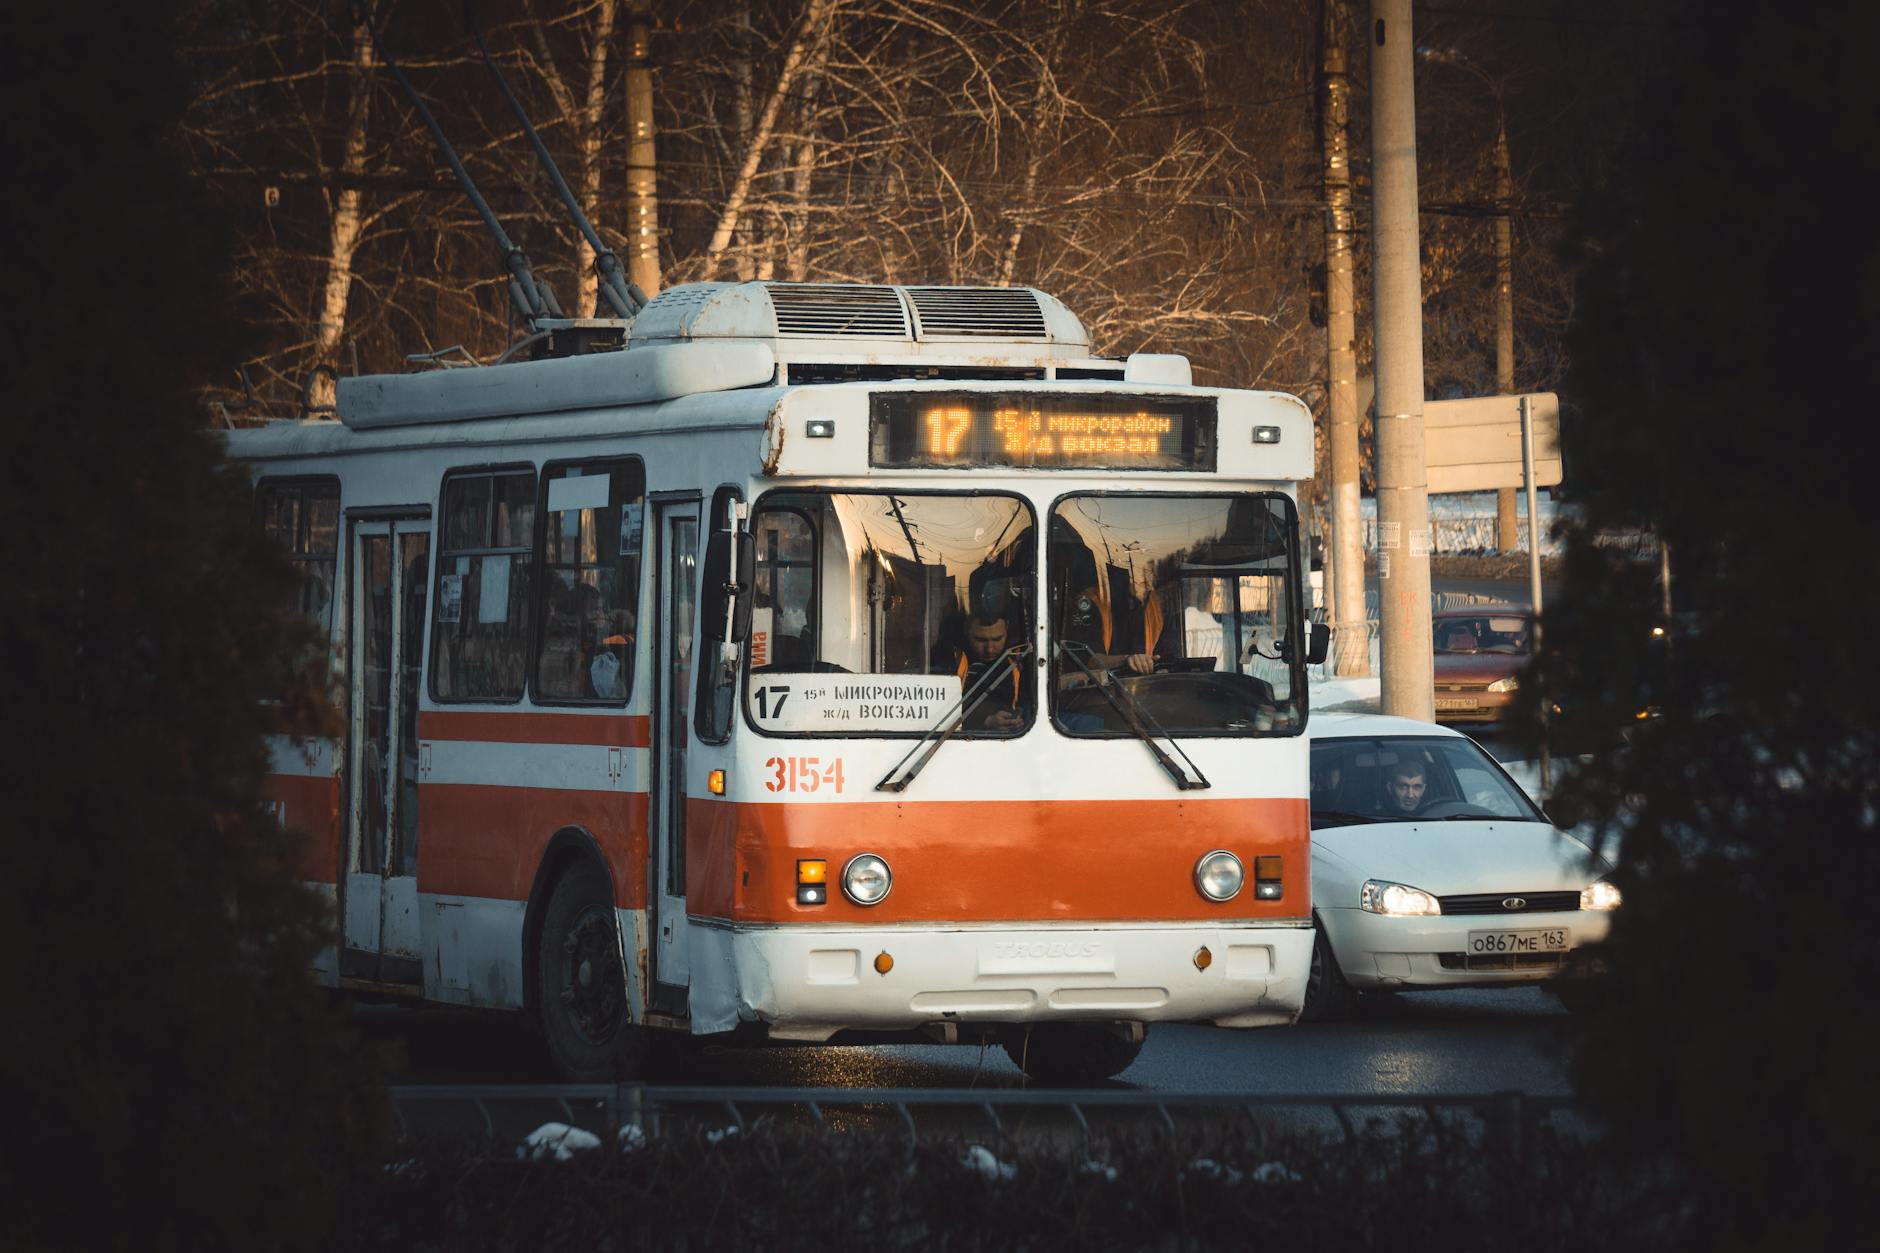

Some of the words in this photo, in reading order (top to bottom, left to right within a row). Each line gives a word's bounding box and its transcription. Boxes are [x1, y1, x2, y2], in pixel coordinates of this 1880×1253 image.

[926, 409, 971, 453] 17
[1049, 412, 1170, 434] микрорайон
[1063, 437, 1158, 453] вокзал
[834, 684, 946, 701] МИКРОРАЙОН
[754, 685, 790, 719] 17
[859, 704, 929, 720] ВОКЗАЛ
[765, 757, 845, 794] 3154
[1541, 931, 1564, 945] 163
[993, 941, 1102, 959] TROBUS
